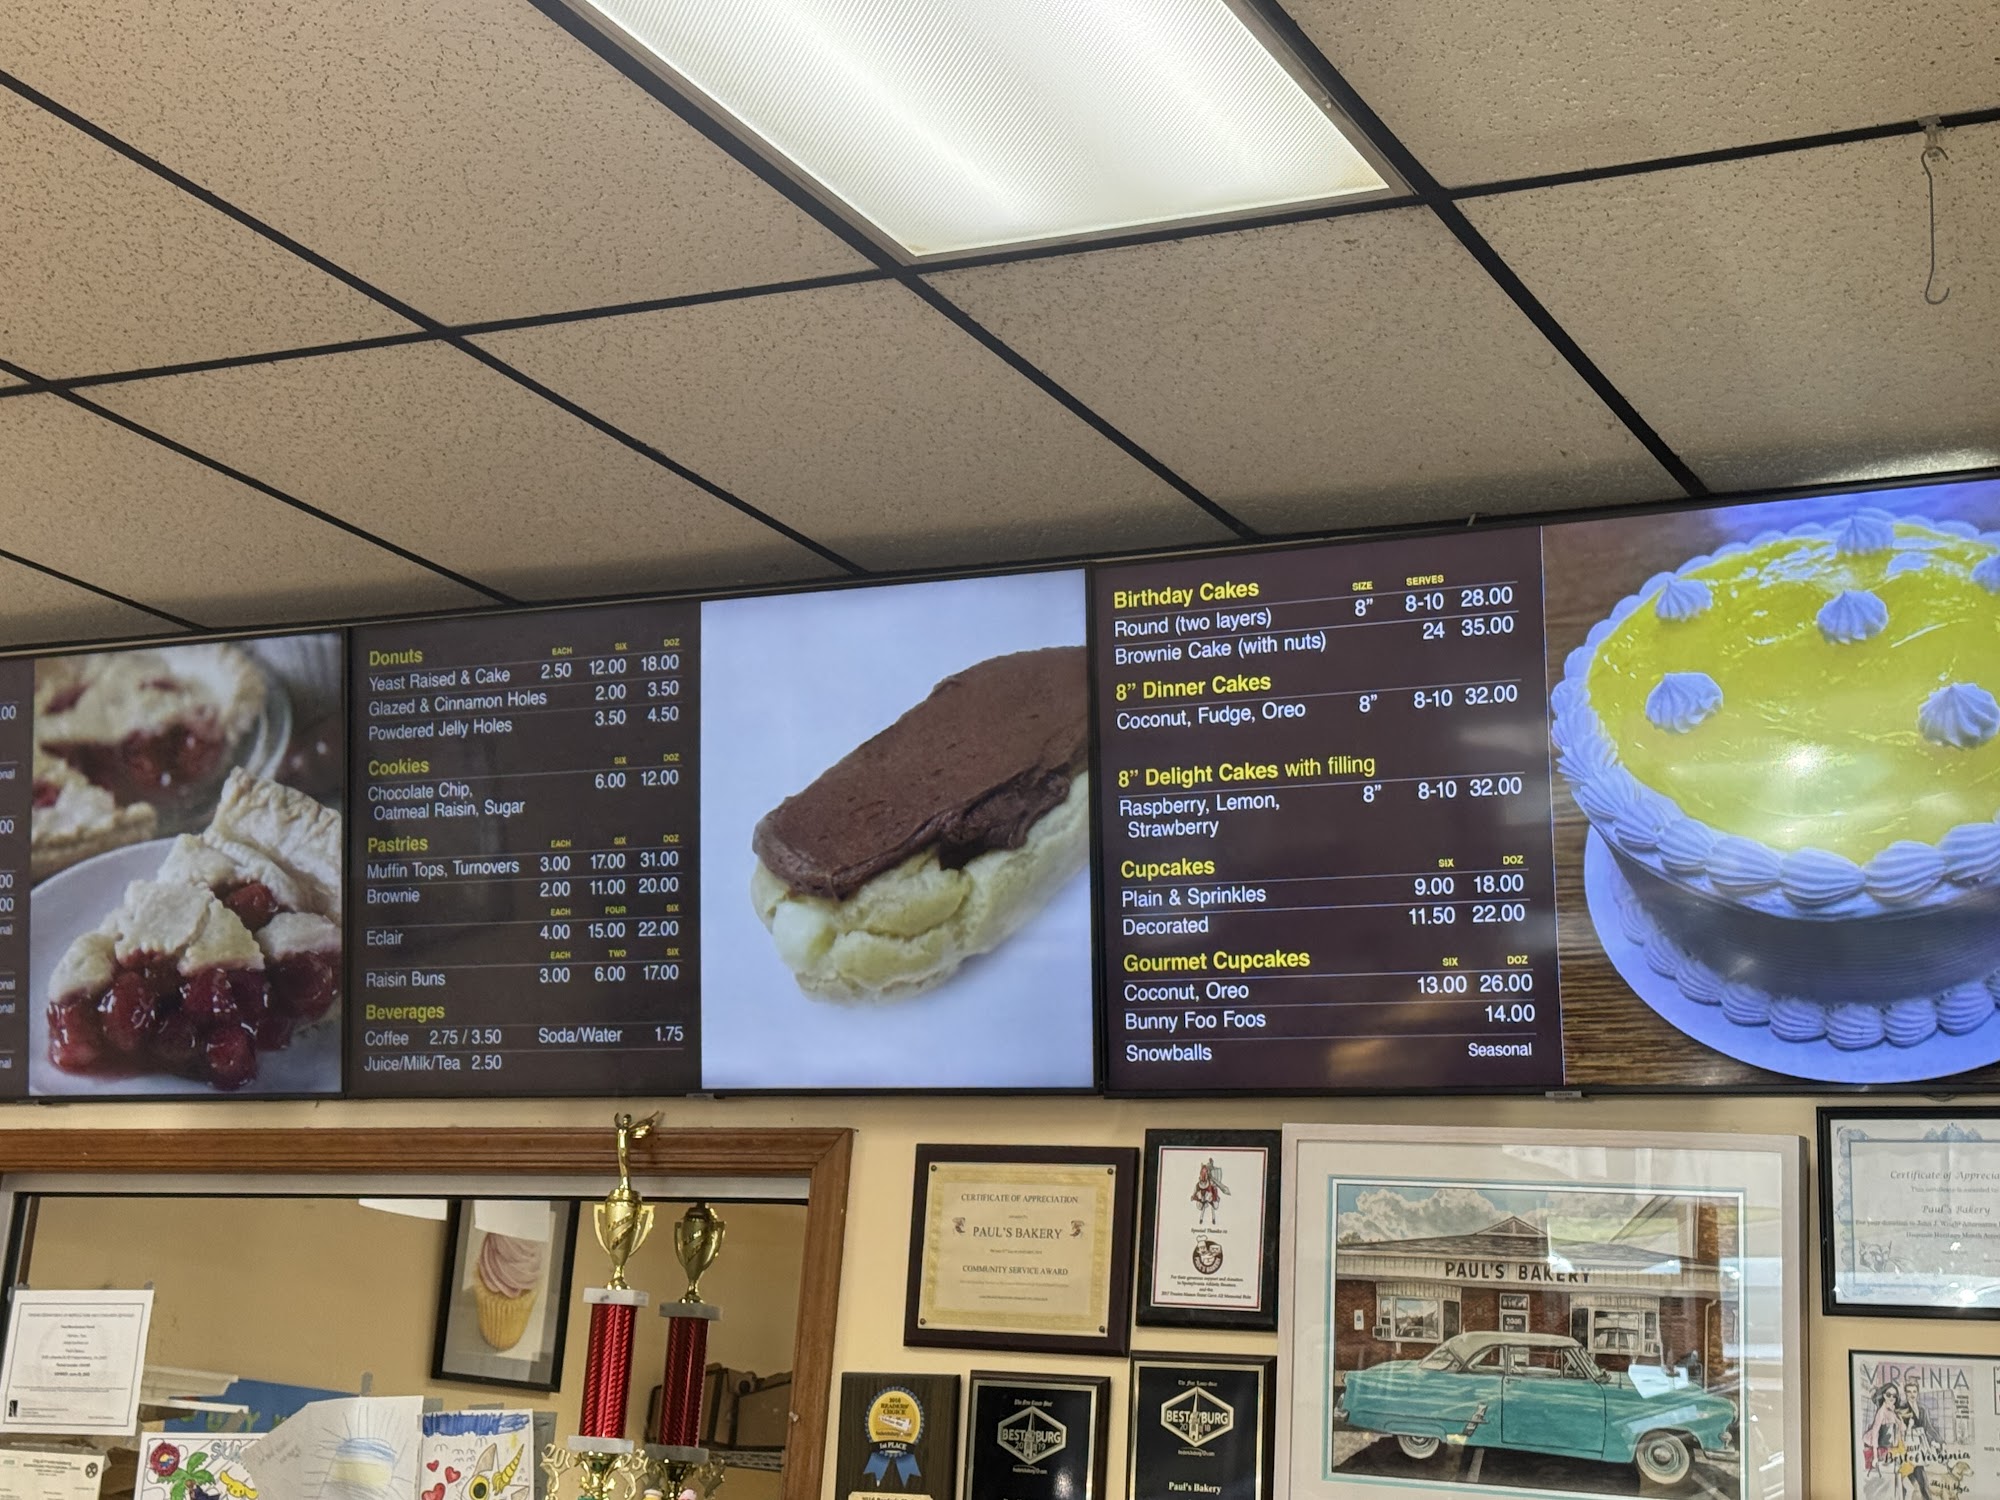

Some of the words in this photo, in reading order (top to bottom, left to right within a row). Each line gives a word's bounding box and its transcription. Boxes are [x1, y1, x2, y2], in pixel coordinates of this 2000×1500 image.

[1114, 586, 1193, 610] Birthday
[1200, 581, 1259, 601] Cakes
[1352, 581, 1373, 591] SIZE
[1406, 575, 1444, 586] SERVES
[1115, 616, 1169, 637] Round
[1175, 613, 1210, 637] (two
[1216, 607, 1272, 631] layers)
[1405, 593, 1444, 613] 8-10
[1461, 586, 1513, 608] 28.00
[369, 649, 423, 666] Donuts
[615, 642, 627, 650] SIX
[664, 639, 680, 647] DOZ
[1115, 644, 1182, 665] Brownie
[1188, 640, 1232, 659] Cake
[1238, 636, 1278, 659] (with
[1284, 631, 1326, 653] nuts)
[1423, 622, 1445, 640] 24
[1461, 616, 1514, 637] 35.00
[369, 674, 405, 691] Yeast
[410, 671, 456, 688] Raised
[461, 670, 469, 684] &
[476, 668, 510, 684] Cake
[541, 662, 571, 679] 2.50
[590, 658, 626, 675] 12.00
[641, 654, 679, 671] 18.00
[369, 700, 415, 716] Glazed
[420, 699, 429, 712] &
[435, 695, 502, 712] Cinnamon
[508, 691, 547, 706] Holes
[595, 684, 626, 700] 2.00
[648, 680, 679, 696] 3.50
[1143, 678, 1206, 698] Dinner
[1212, 673, 1271, 693] Cakes
[1117, 710, 1191, 730] Coconut,
[1198, 704, 1255, 725] Fudge,
[1262, 700, 1306, 720] Oreo
[1413, 691, 1452, 710] 8-10
[1465, 685, 1517, 705] 32.00
[369, 724, 433, 740] Powdered
[438, 721, 468, 738] Jelly
[473, 718, 512, 733] Holes
[595, 710, 626, 726] 3.50
[648, 706, 678, 722] 4.50
[368, 759, 429, 776] Cookies
[614, 756, 626, 765] SIX
[663, 753, 679, 761] DOZ
[1145, 765, 1213, 787] Delight
[1219, 761, 1278, 781] Cakes
[1285, 757, 1322, 776] with
[1328, 754, 1375, 776] filling
[368, 784, 433, 801] Chocolate
[438, 782, 473, 799] Chip,
[595, 773, 626, 789] 6.00
[641, 770, 678, 786] 12.00
[1119, 797, 1210, 819] Raspberry,
[1216, 793, 1280, 813] Lemon,
[1418, 781, 1457, 799] 8-10
[1469, 777, 1522, 796] 32.00
[374, 804, 429, 821] Oatmeal
[434, 801, 479, 818] Raisin,
[485, 799, 525, 818] Sugar
[1128, 820, 1219, 839] Strawberry
[368, 836, 428, 852] Pastries
[551, 840, 571, 848] EACH
[614, 837, 626, 845] SIX
[663, 835, 679, 843] DOZ
[367, 863, 407, 879] Muffin
[413, 861, 448, 879] Tops,
[453, 859, 519, 875] Turnovers
[540, 856, 570, 871] 3.00
[590, 853, 625, 869] 17.00
[640, 851, 678, 866] 31.00
[1121, 858, 1215, 880] Cupcakes
[1438, 858, 1454, 868] SIX
[1503, 855, 1524, 865] DOZ
[367, 888, 420, 904] Brownie
[540, 882, 570, 897] 2.00
[590, 879, 625, 895] 11.00
[639, 877, 678, 893] 20.00
[1122, 888, 1162, 907] Plain
[1169, 888, 1181, 906] &
[1187, 885, 1266, 907] Sprinkles
[1415, 877, 1454, 896] 9.00
[1473, 874, 1524, 894] 18.00
[550, 908, 571, 916] EACH
[605, 906, 626, 914] FOUR
[666, 904, 679, 912] SIX
[1123, 916, 1209, 936] Decorated
[1409, 906, 1455, 925] 11.50
[1472, 904, 1525, 923] 22.00
[367, 929, 404, 945] Eclair
[540, 924, 570, 940] 4.00
[588, 922, 625, 938] 15.00
[638, 921, 678, 936] 22.00
[550, 951, 571, 959] EACH
[609, 949, 626, 957] TWO
[666, 948, 679, 956] SIX
[1124, 952, 1207, 972] Gourmet
[1213, 949, 1310, 971] Cupcakes
[1442, 957, 1458, 966] SIX
[1507, 955, 1528, 965] DOZ
[366, 972, 406, 987] Raisin
[412, 970, 445, 985] Buns
[539, 968, 570, 983] 3.00
[595, 966, 625, 981] 6.00
[643, 965, 678, 980] 17.00
[1124, 982, 1199, 1002] Coconut,
[1206, 981, 1249, 1000] Oreo
[1417, 977, 1467, 995] 13.00
[1479, 974, 1533, 992] 26.00
[366, 1004, 445, 1022] Beverages
[1125, 1012, 1178, 1033] Bunny
[1184, 1011, 1217, 1029] Foo
[1223, 1010, 1266, 1028] Foos
[1485, 1004, 1535, 1022] 14.00
[365, 1030, 409, 1046] Coffee
[429, 1030, 458, 1045] 2.75
[462, 1029, 468, 1044] /
[472, 1029, 501, 1044] 3.50
[539, 1027, 622, 1043] Soda/Water
[655, 1026, 683, 1041] 1.75
[364, 1056, 460, 1072] Juice/Milk/Tea
[472, 1055, 502, 1070] 2.50
[1126, 1044, 1212, 1062] Snowballs
[1468, 1042, 1531, 1057] Seasonal
[961, 1194, 1009, 1202] CERTIFICATE
[1024, 1195, 1078, 1203] APPRECIATION
[973, 1227, 1012, 1237] PAUL'S
[1015, 1228, 1062, 1239] BAKERY
[963, 1265, 1007, 1273] COMMUNITY
[1445, 1262, 1505, 1279] PAUL'S
[1863, 1363, 1969, 1390] VIRGINIA
[1168, 1482, 1192, 1491] Paul's
[1194, 1483, 1222, 1495] Bakery
